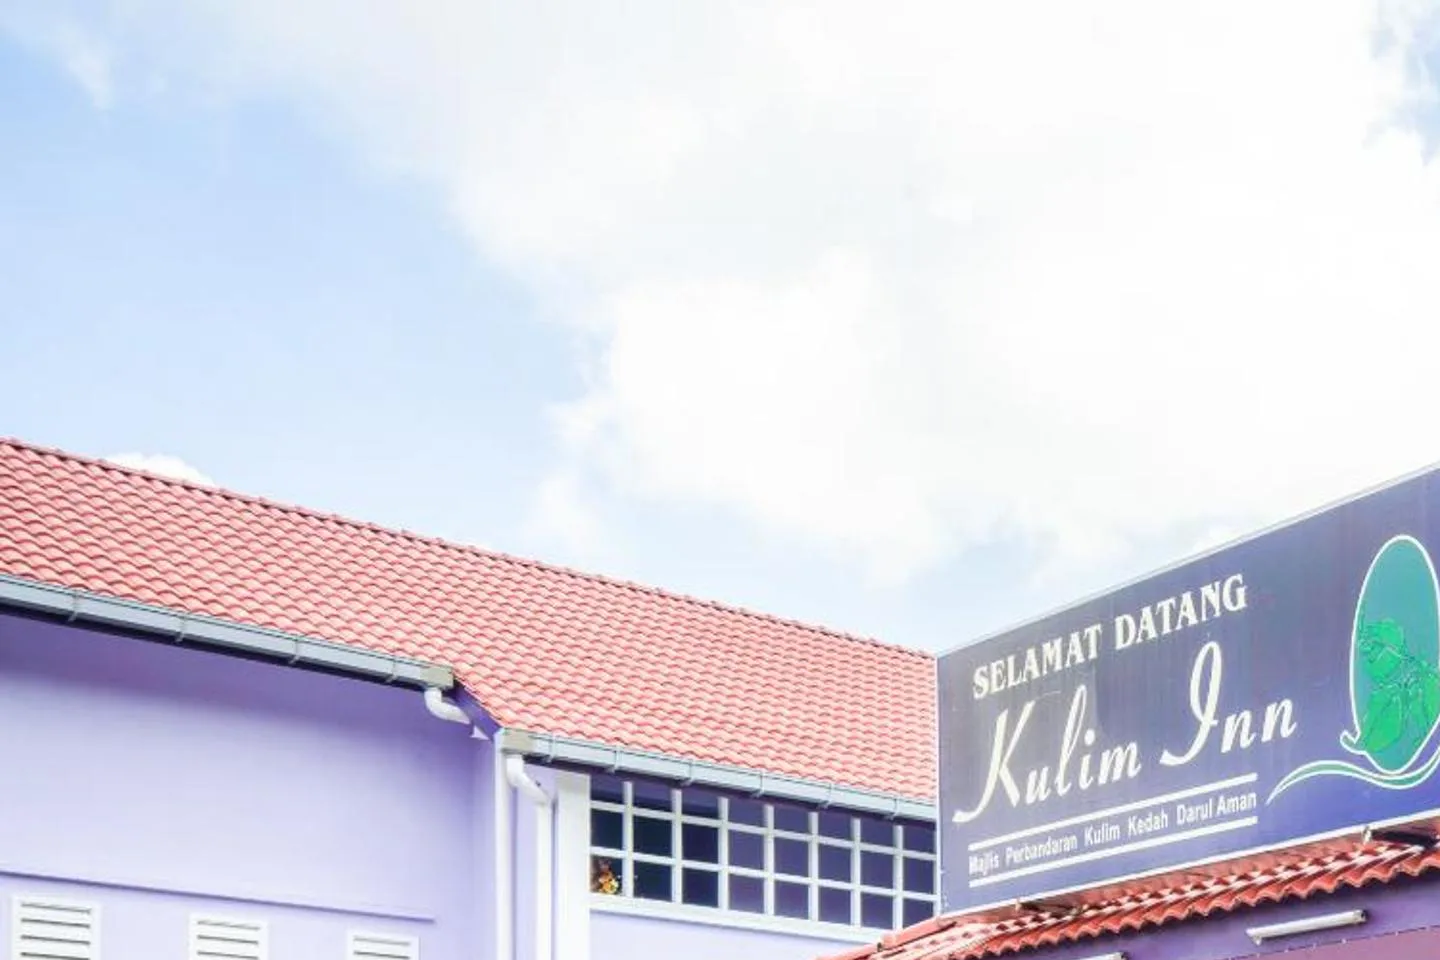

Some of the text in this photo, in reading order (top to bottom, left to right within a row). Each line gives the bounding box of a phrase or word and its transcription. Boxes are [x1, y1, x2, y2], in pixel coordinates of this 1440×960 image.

[972, 573, 1248, 700] SELAMAT DATANG
[952, 640, 1298, 823] Kulim Inn
[968, 791, 1257, 877] Majlis Perbandaran Kulim Kedah Darul Aman
